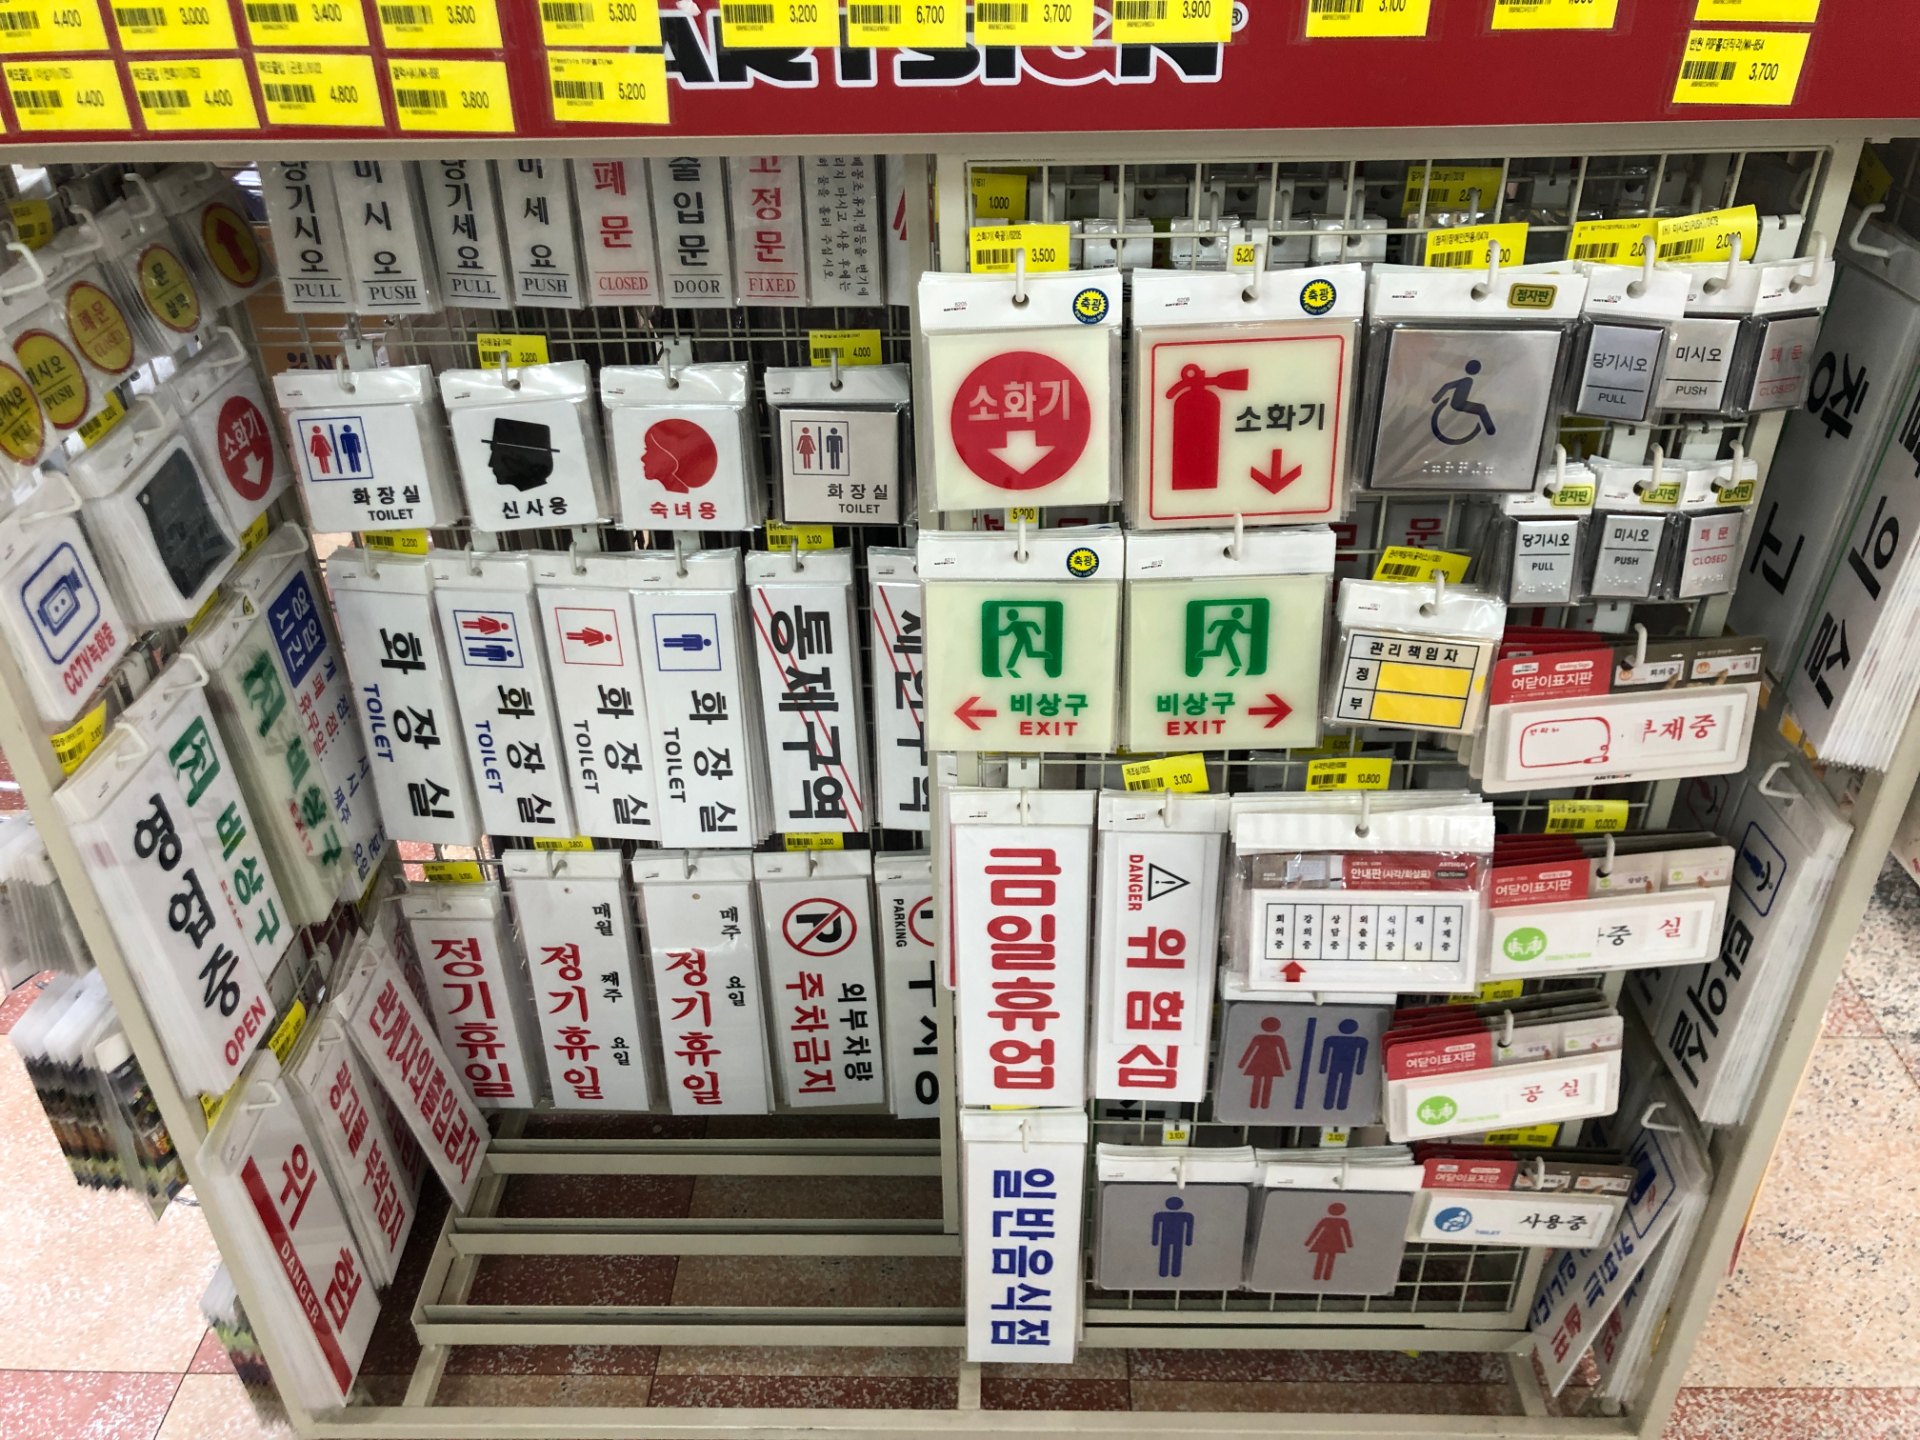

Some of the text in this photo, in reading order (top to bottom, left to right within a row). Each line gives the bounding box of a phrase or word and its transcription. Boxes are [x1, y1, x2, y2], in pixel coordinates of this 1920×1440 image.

[53, 9, 82, 27] 4,400
[179, 7, 209, 25] 3,000
[313, 4, 342, 22] 3,400
[446, 6, 476, 24] 3,500
[608, 4, 637, 22] 5,300
[789, 5, 818, 24] 3,200
[915, 6, 945, 25] 6,700
[1043, 5, 1072, 24] 3,700
[1182, 2, 1212, 20] 3,900
[1748, 63, 1779, 81] 3,700
[76, 89, 105, 107] 4,400
[203, 88, 233, 107] 4,400
[618, 82, 646, 101] 5,200
[1031, 249, 1056, 263] 3,500
[294, 283, 341, 298] PULL
[452, 277, 496, 295] PULL
[523, 277, 569, 293] PUSH
[598, 275, 649, 291] CLOSED
[673, 279, 721, 294] DOOR
[748, 277, 797, 293] FIXED
[367, 285, 418, 301] PUSH
[1308, 288, 1329, 302] 축광
[1516, 289, 1550, 303] 점자판
[1080, 297, 1102, 312] 축광
[1593, 352, 1649, 374] 당기시오
[1675, 346, 1723, 363] 미시오
[1597, 392, 1628, 405] PULL
[1675, 385, 1708, 396] PUSH
[968, 379, 1071, 422] 소화기
[1234, 402, 1326, 434] 소화기
[223, 407, 264, 462] 소화기
[352, 484, 421, 506] 화장실
[827, 482, 889, 502] 화장실
[367, 508, 414, 522] TOILET
[502, 496, 568, 521] 신사용
[649, 501, 718, 521] 숙녀용
[838, 503, 881, 515] TOILET
[1521, 533, 1571, 549] 당기시오
[1614, 527, 1650, 542] 미시오
[1531, 562, 1555, 572] PULL
[1613, 555, 1640, 566] PUSH
[1692, 553, 1728, 567] CLOSED
[1369, 641, 1459, 663] 관리책임자
[1356, 667, 1370, 681] 정
[1511, 670, 1594, 691] 여닫이표지판
[769, 605, 848, 820] 통제구역
[1010, 693, 1090, 717] 비상구
[1156, 692, 1237, 716] 비상구
[1350, 697, 1363, 711] 부
[363, 684, 394, 763] TOILET
[380, 628, 455, 819] 화장실
[1019, 720, 1079, 737] EXIT
[1167, 719, 1226, 736] EXIT
[475, 720, 504, 794] TOILET
[497, 684, 556, 825] 화장실
[573, 719, 600, 794] TOILET
[596, 684, 652, 826] 화장실
[688, 690, 739, 833] 화장실
[663, 727, 687, 803] TOILET
[1174, 773, 1193, 785] 3,100
[215, 800, 282, 946] 비상구
[1350, 867, 1382, 881] 안내판
[1127, 854, 1144, 912] DANGER
[1495, 879, 1574, 896] 여닫이표지판
[133, 792, 241, 1018] 영업중
[893, 898, 908, 948] PARKING
[719, 906, 746, 1008] 매주 요일
[984, 848, 1062, 1090] 금일휴업
[592, 902, 631, 1067] 매월 째주 요일
[1126, 926, 1187, 1032] 위험
[431, 938, 516, 1098] 정기휴일
[540, 943, 605, 1100] 정기휴일
[665, 947, 723, 1105] 정기휴일
[223, 995, 268, 1067] OPEN
[785, 970, 837, 1094] 주차금지
[837, 981, 874, 1082] 외부차량
[1520, 1212, 1589, 1231] 사용중
[281, 1142, 363, 1334] 위험
[990, 1167, 1057, 1347] 일반음식점
[279, 1243, 321, 1325] DANGER
